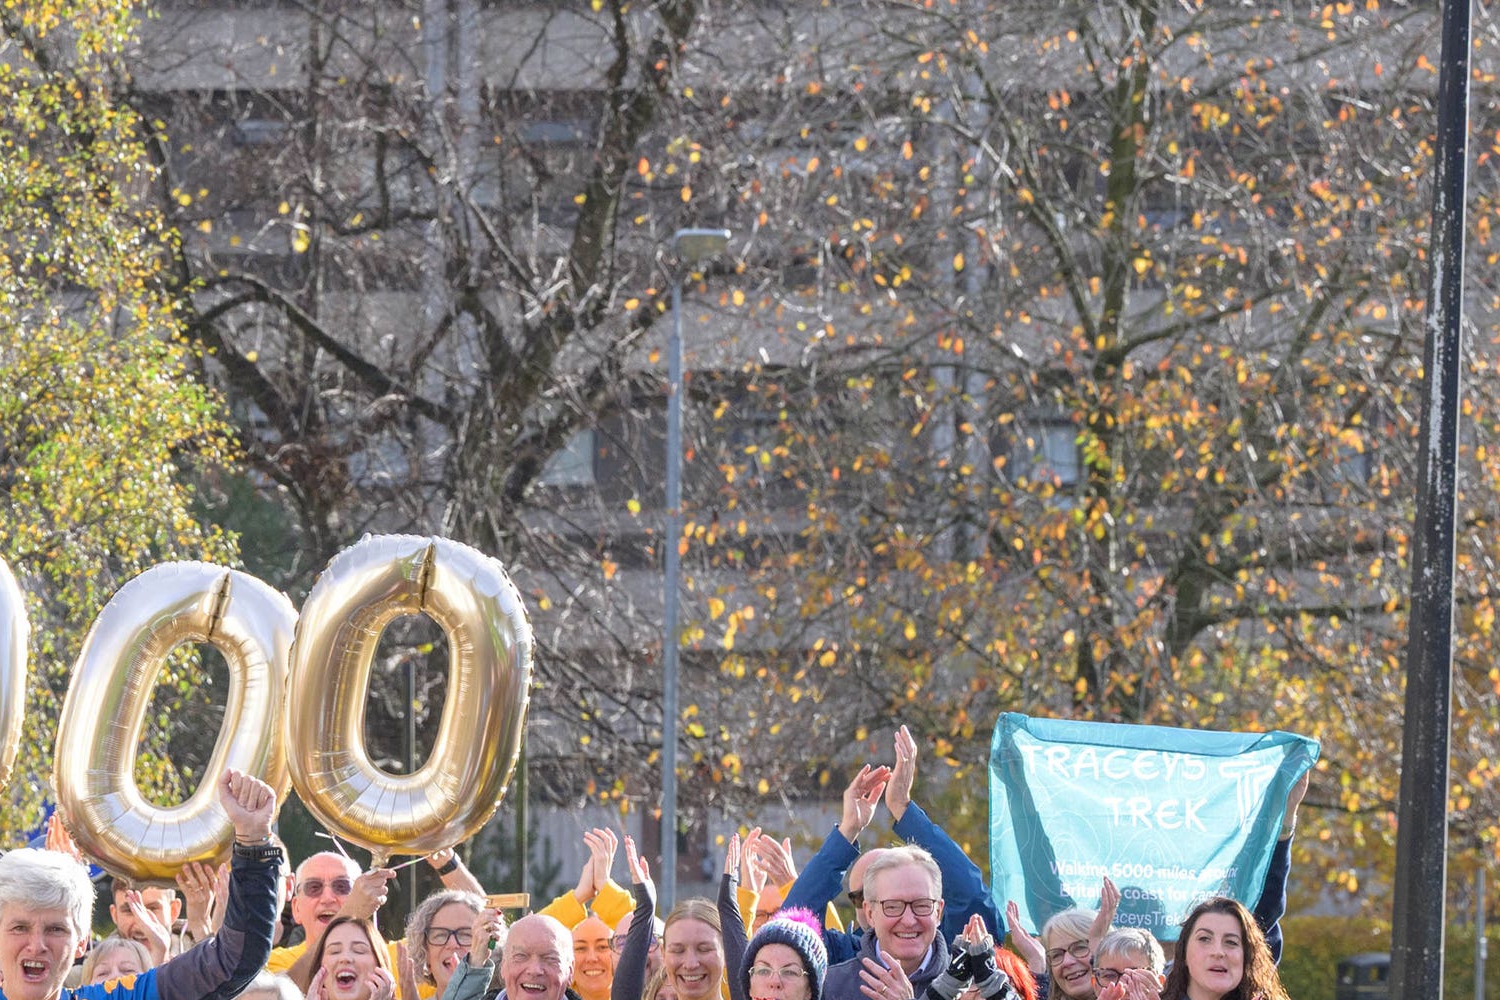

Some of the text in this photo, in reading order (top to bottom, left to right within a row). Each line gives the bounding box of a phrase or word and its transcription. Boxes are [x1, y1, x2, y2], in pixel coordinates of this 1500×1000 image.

[1020, 745, 1206, 781] TRACEYS
[1103, 796, 1208, 833] TREK
[1112, 863, 1154, 879] 5000
[1157, 865, 1196, 880] miles
[1123, 884, 1164, 900] coast
[1167, 886, 1188, 901] for
[1113, 910, 1181, 927] aceysTrek
